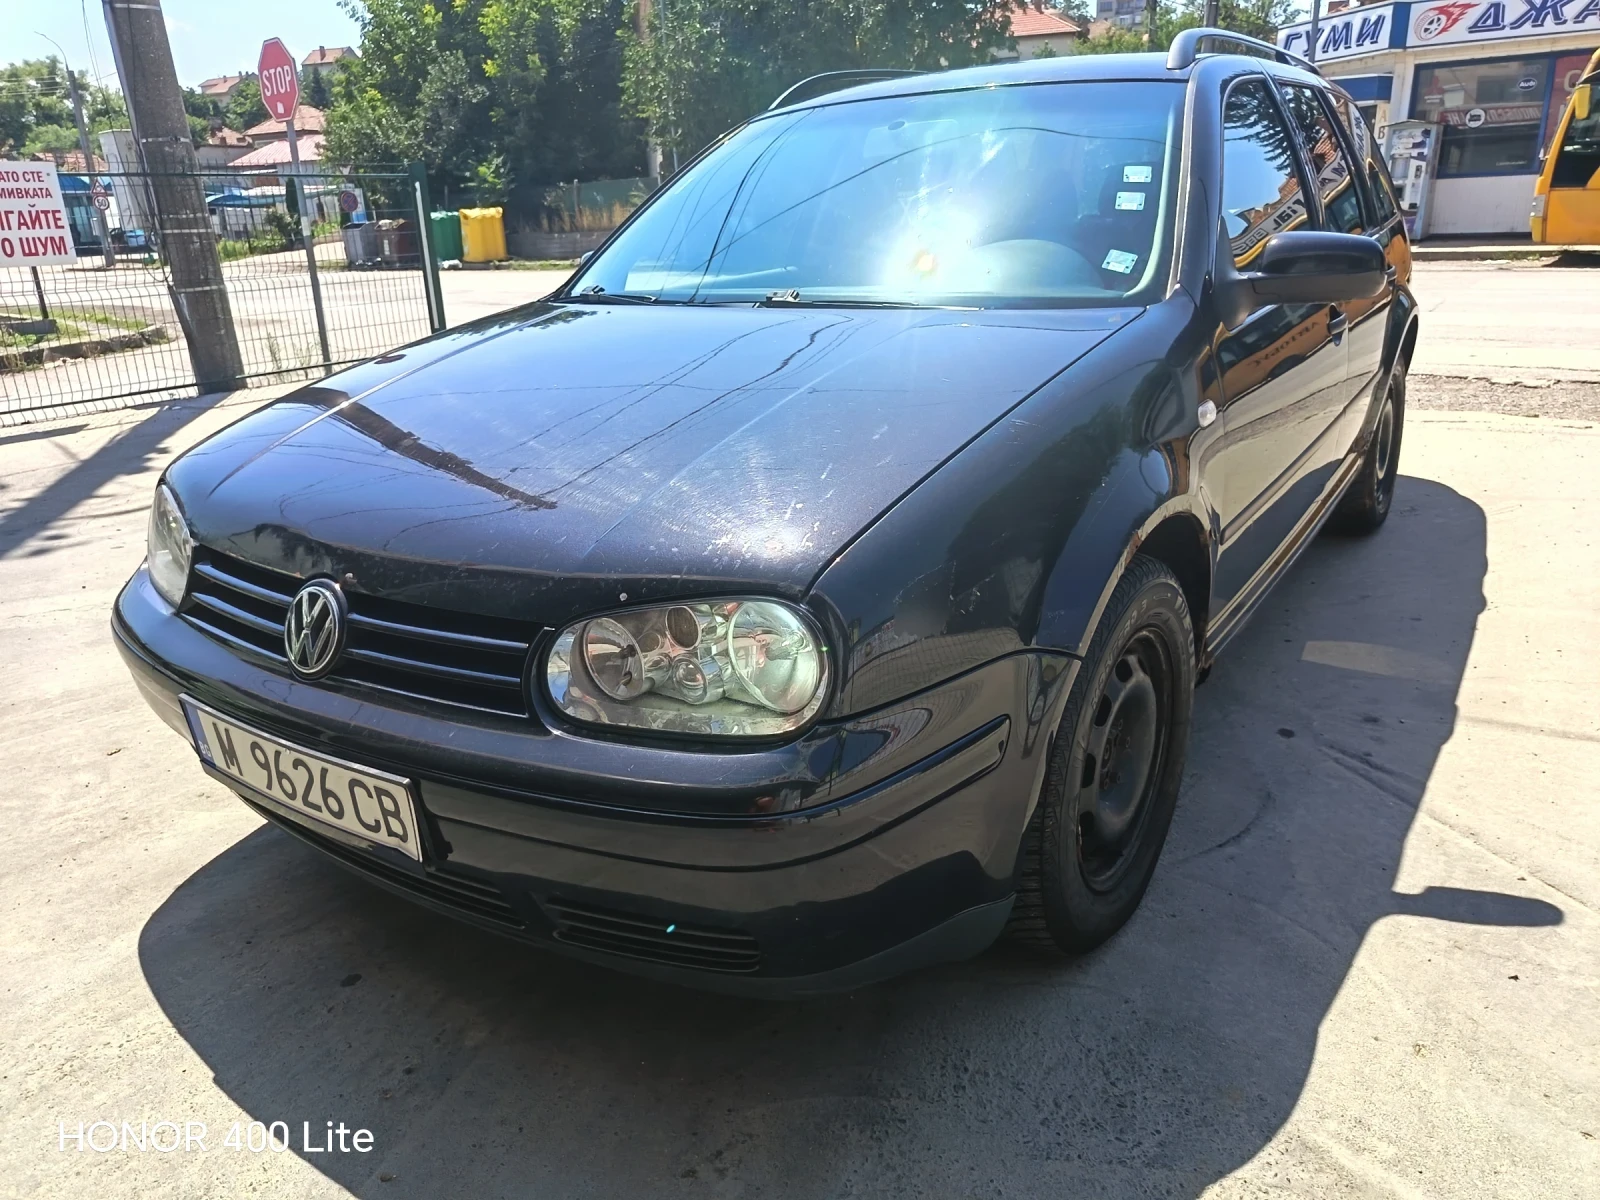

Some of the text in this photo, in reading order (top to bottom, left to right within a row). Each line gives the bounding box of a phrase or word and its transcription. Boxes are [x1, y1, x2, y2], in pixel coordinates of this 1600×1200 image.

[262, 65, 292, 97] STOP
[22, 171, 45, 182] СТЕ
[0, 236, 68, 258] О ШУМ
[198, 739, 213, 758] BG
